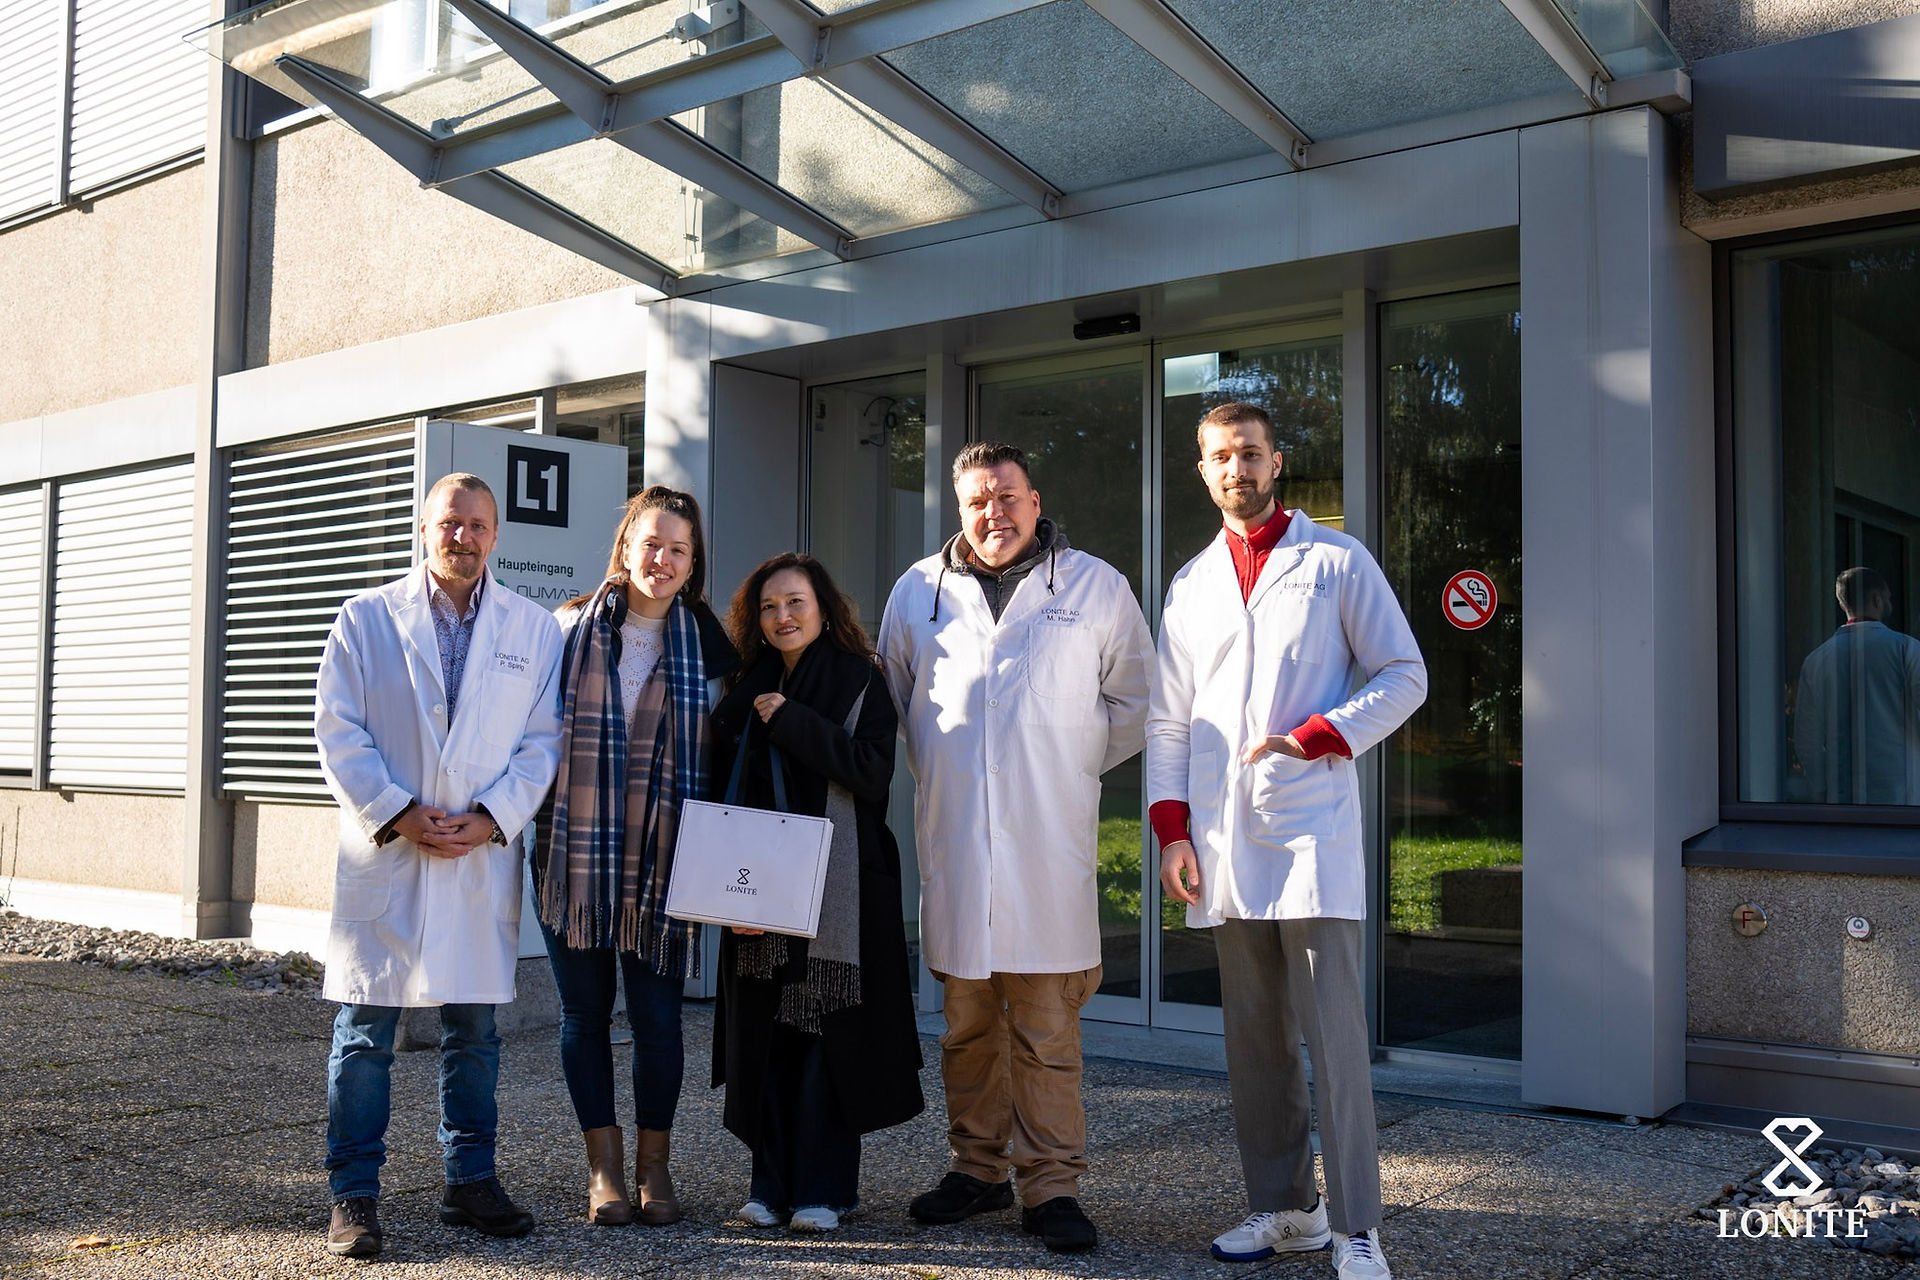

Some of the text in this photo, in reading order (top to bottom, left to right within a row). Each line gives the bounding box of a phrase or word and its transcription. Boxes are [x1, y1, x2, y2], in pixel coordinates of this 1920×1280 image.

[516, 460, 558, 512] L1
[498, 558, 574, 577] Haupteingang
[1314, 583, 1326, 591] AG
[1742, 910, 1755, 929] F
